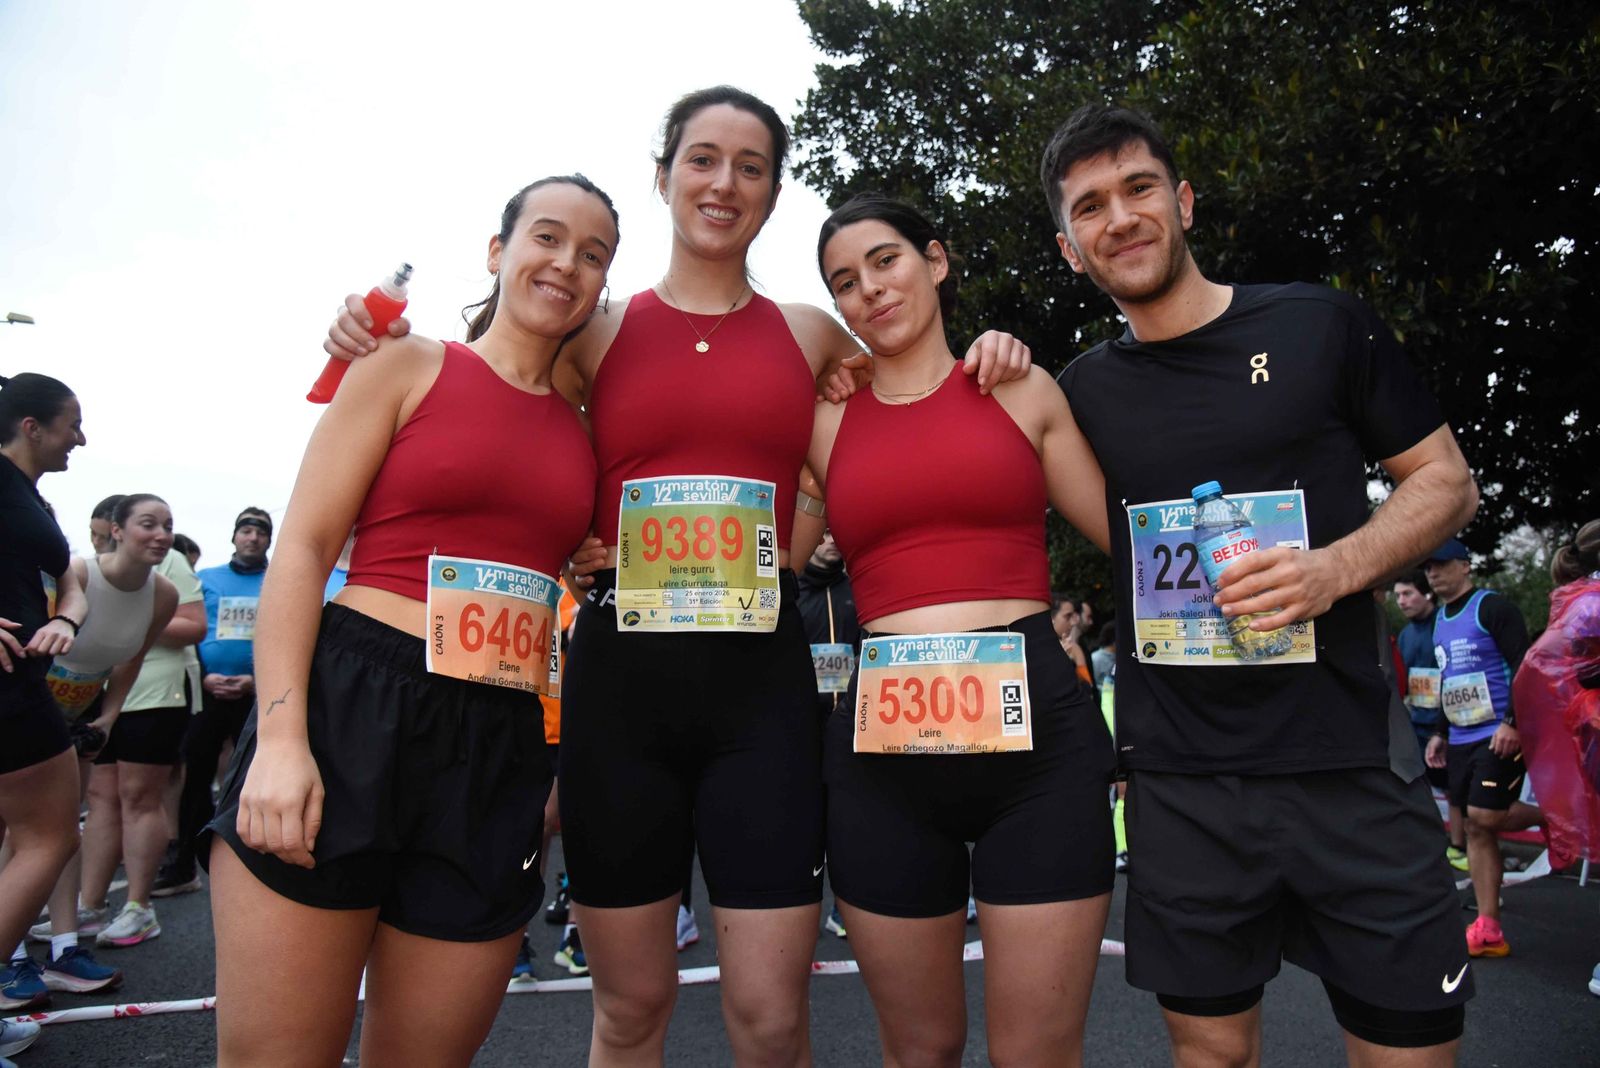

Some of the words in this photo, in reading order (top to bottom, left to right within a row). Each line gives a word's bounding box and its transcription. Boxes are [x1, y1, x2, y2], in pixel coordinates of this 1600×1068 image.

[671, 480, 728, 491] maratón
[683, 489, 728, 501] sevilla
[641, 515, 744, 562] 9389
[669, 564, 689, 574] leire
[690, 565, 715, 576] gurru
[1153, 542, 1211, 591] 22
[495, 568, 544, 589] maratón
[508, 584, 543, 600] sevilla
[223, 608, 257, 621] 2115
[670, 615, 695, 623] HOKA
[1159, 610, 1178, 618] Jokin
[1179, 610, 1206, 619] Salegi
[435, 624, 444, 655] CAJÓN
[459, 602, 548, 664] 6464
[906, 638, 966, 651] maratón
[1184, 647, 1210, 655] HOKA
[918, 648, 966, 661] sevilla
[499, 660, 521, 673] Elene
[468, 673, 496, 685] Andrea
[498, 677, 523, 688] Gómez
[878, 675, 985, 725] 5300
[1443, 686, 1480, 706] 22664
[860, 702, 868, 732] CAJÓN
[918, 728, 942, 738] Leire
[882, 744, 901, 752] Leire
